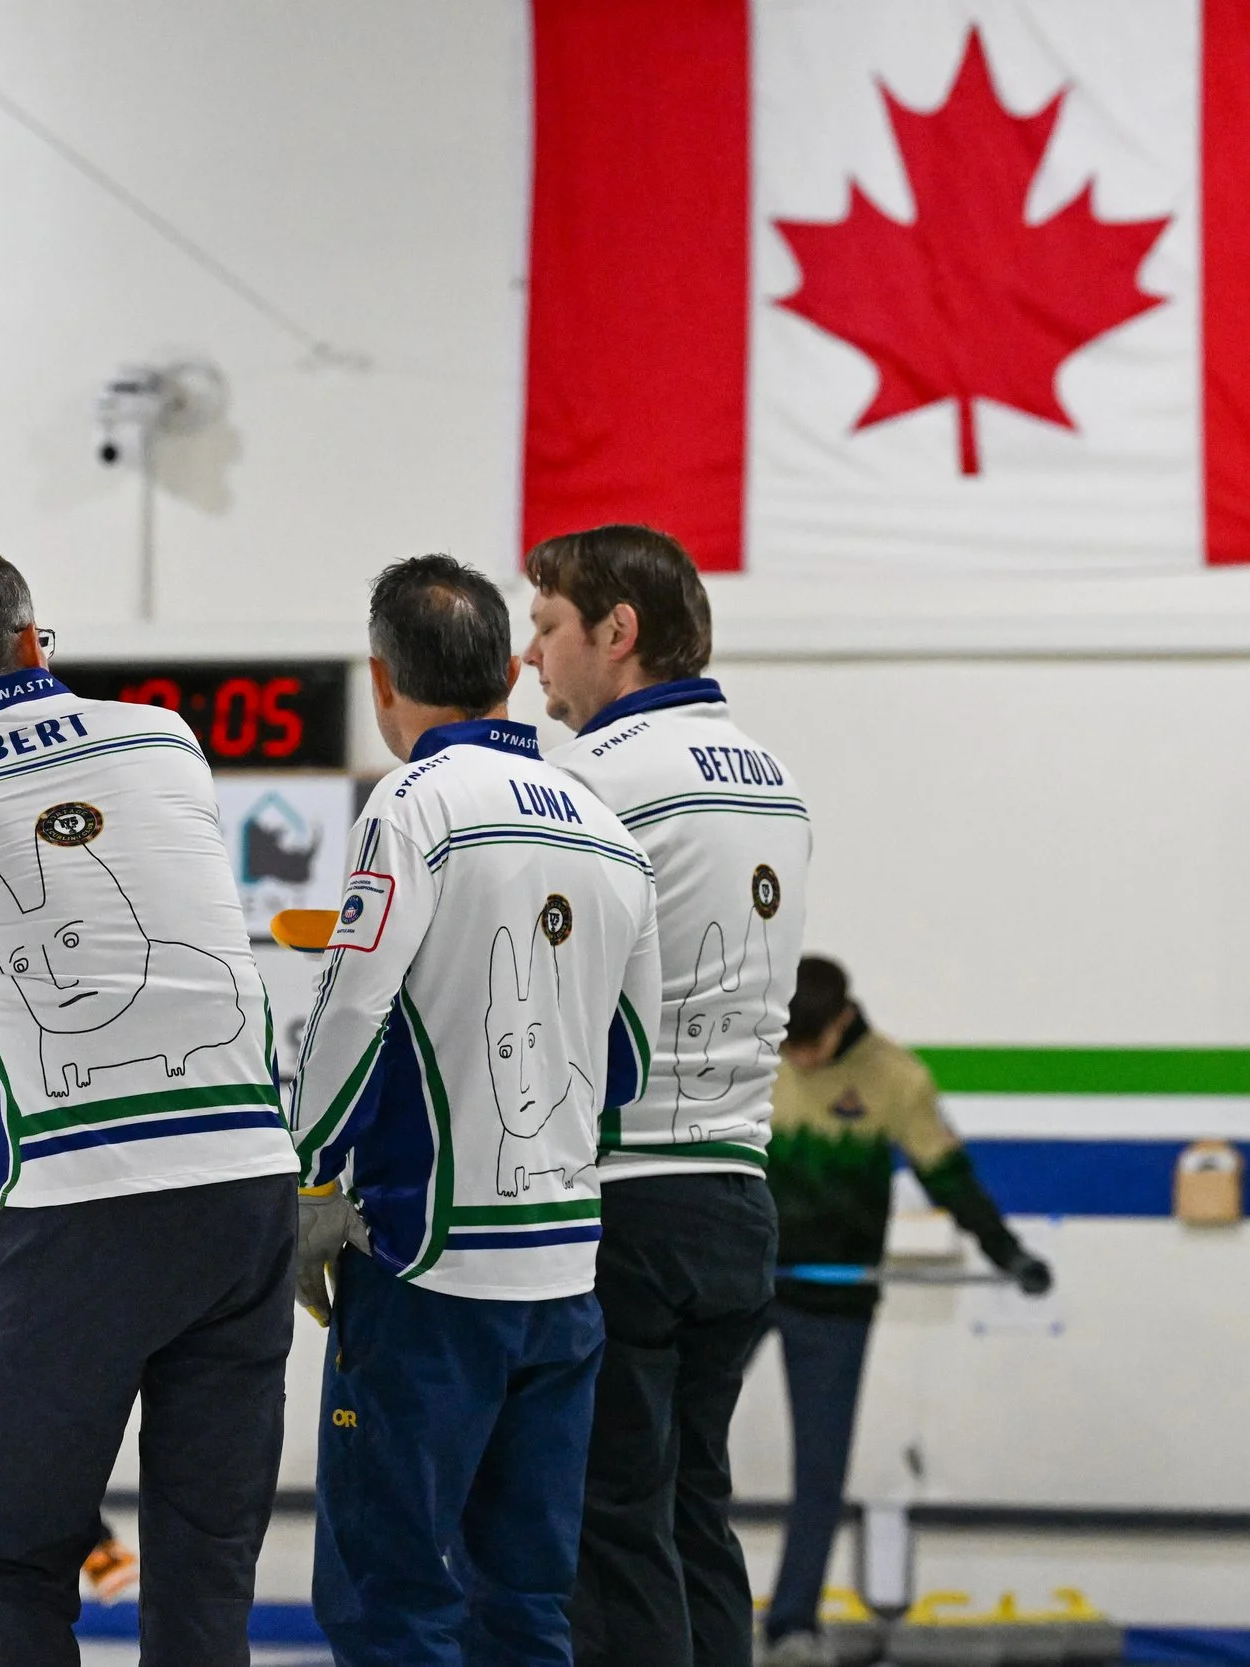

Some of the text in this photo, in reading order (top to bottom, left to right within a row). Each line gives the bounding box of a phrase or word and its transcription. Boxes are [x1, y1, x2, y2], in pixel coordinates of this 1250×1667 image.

[490, 729, 539, 750] DYNAST
[591, 721, 651, 758] DYNASTY
[395, 754, 450, 799] DYNASTY
[689, 746, 785, 787] BETZOLD
[509, 779, 583, 825] LUNA
[332, 1408, 358, 1428] OR
